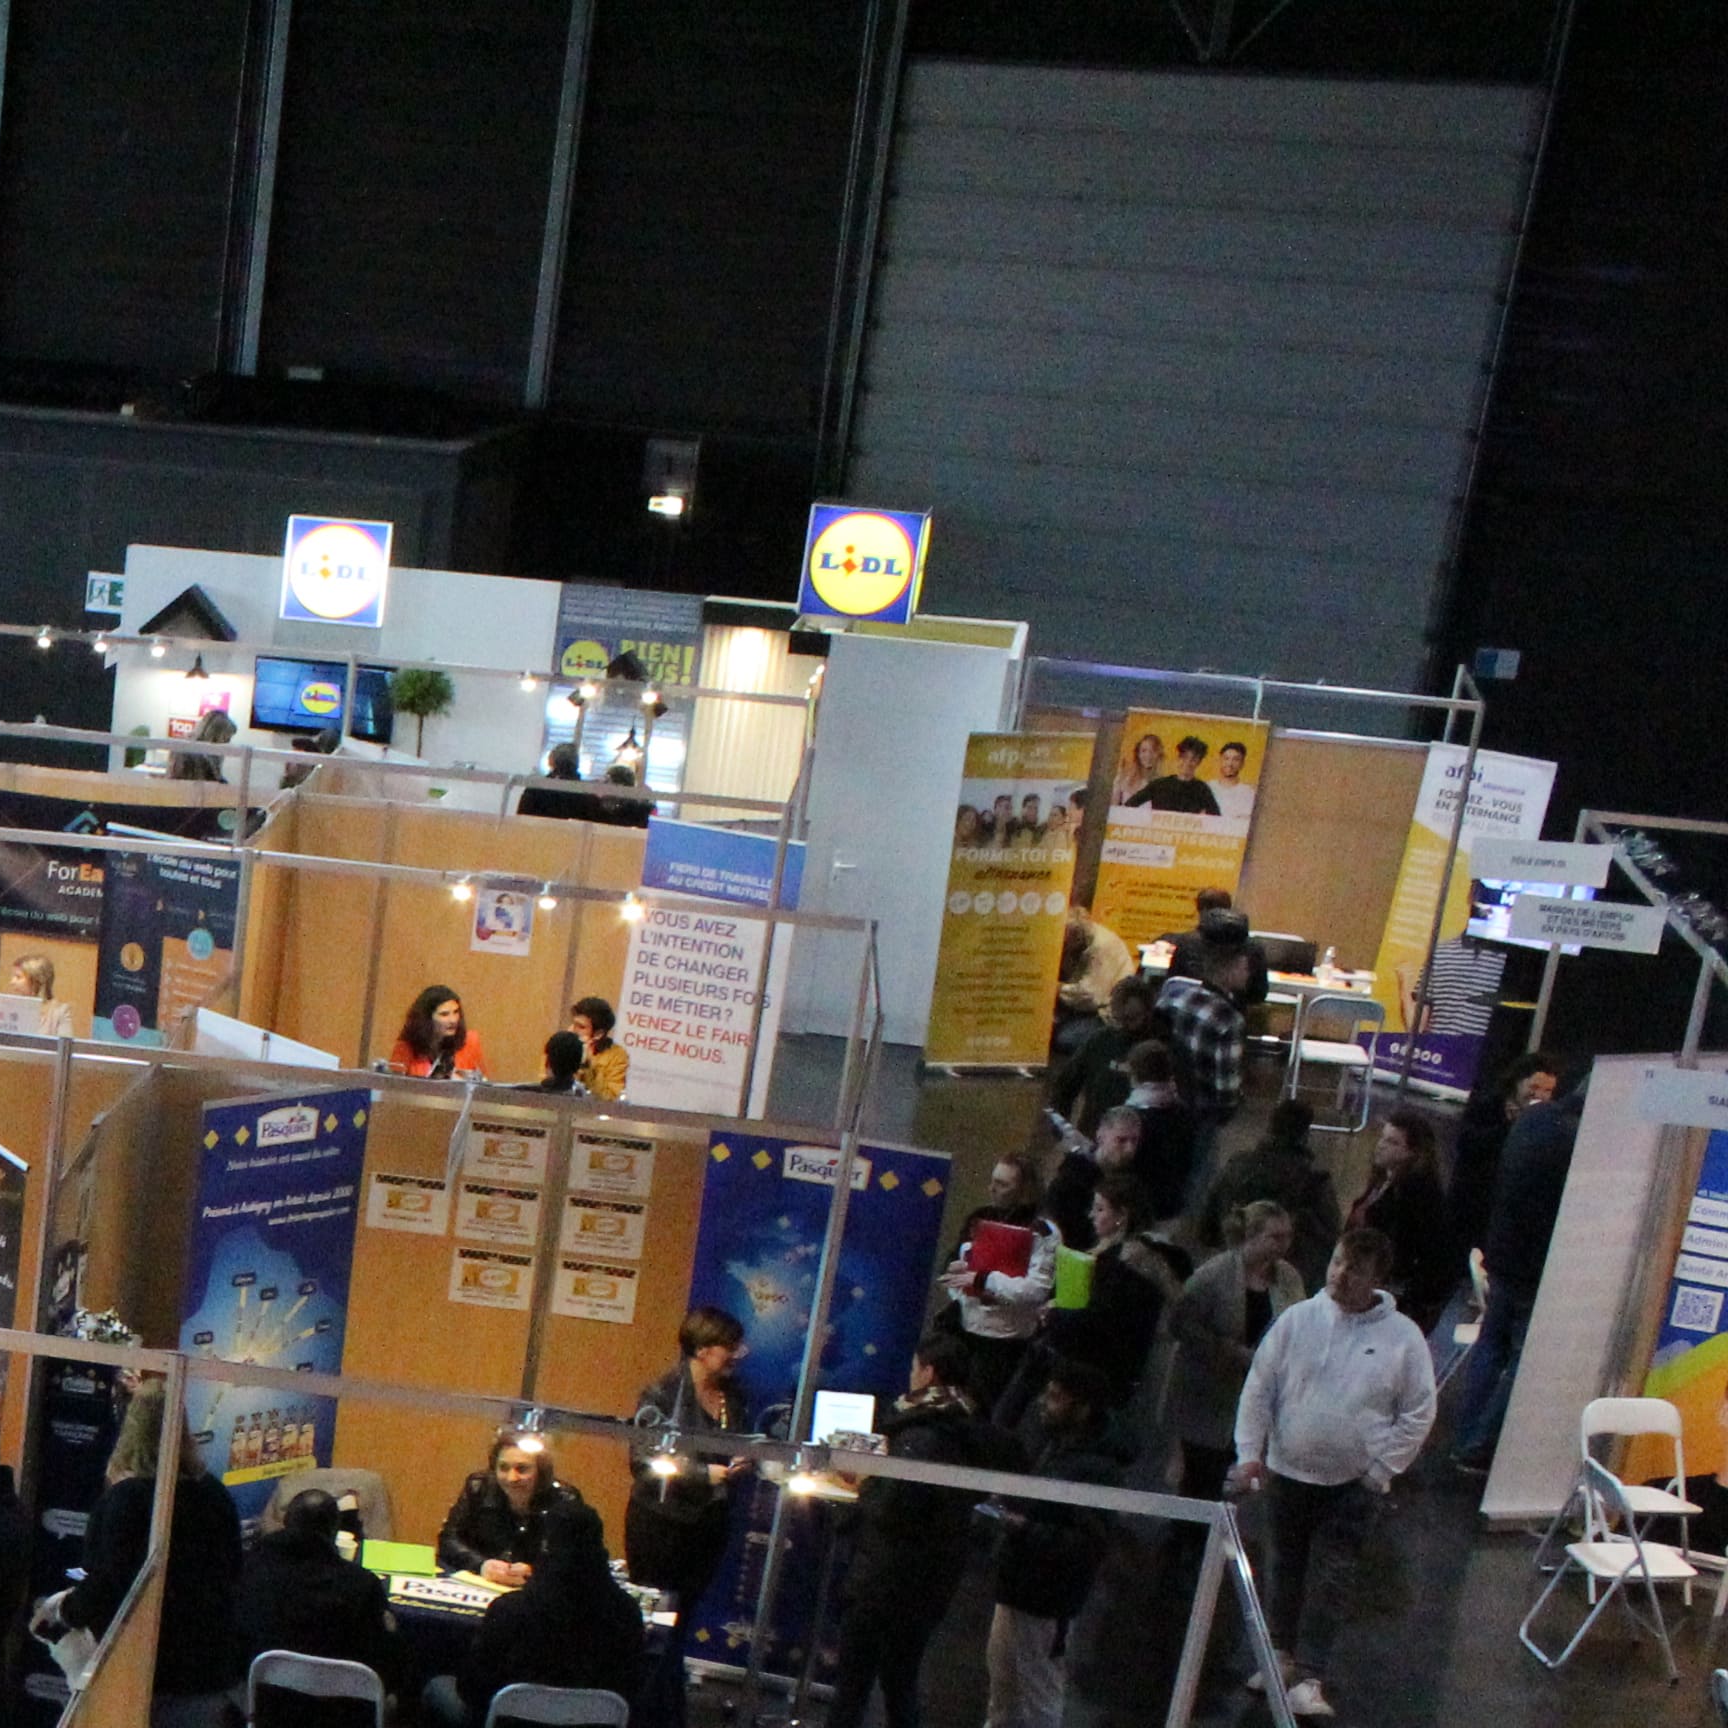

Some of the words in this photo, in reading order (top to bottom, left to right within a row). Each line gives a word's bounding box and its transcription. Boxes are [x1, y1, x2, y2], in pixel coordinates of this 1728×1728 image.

[646, 909, 691, 930] VOUS
[694, 918, 737, 938] AVEZ
[639, 930, 744, 961] L'INTENTION
[636, 950, 659, 967] DE
[663, 955, 749, 983] CHANGER
[633, 971, 728, 1001] PLUSIEURS
[629, 991, 653, 1008] DE
[657, 996, 722, 1021] MÉTIER
[626, 1011, 681, 1033] VENEZ
[685, 1024, 706, 1039] LE
[623, 1032, 670, 1054] CHEZ
[261, 1121, 314, 1139] Pasquier
